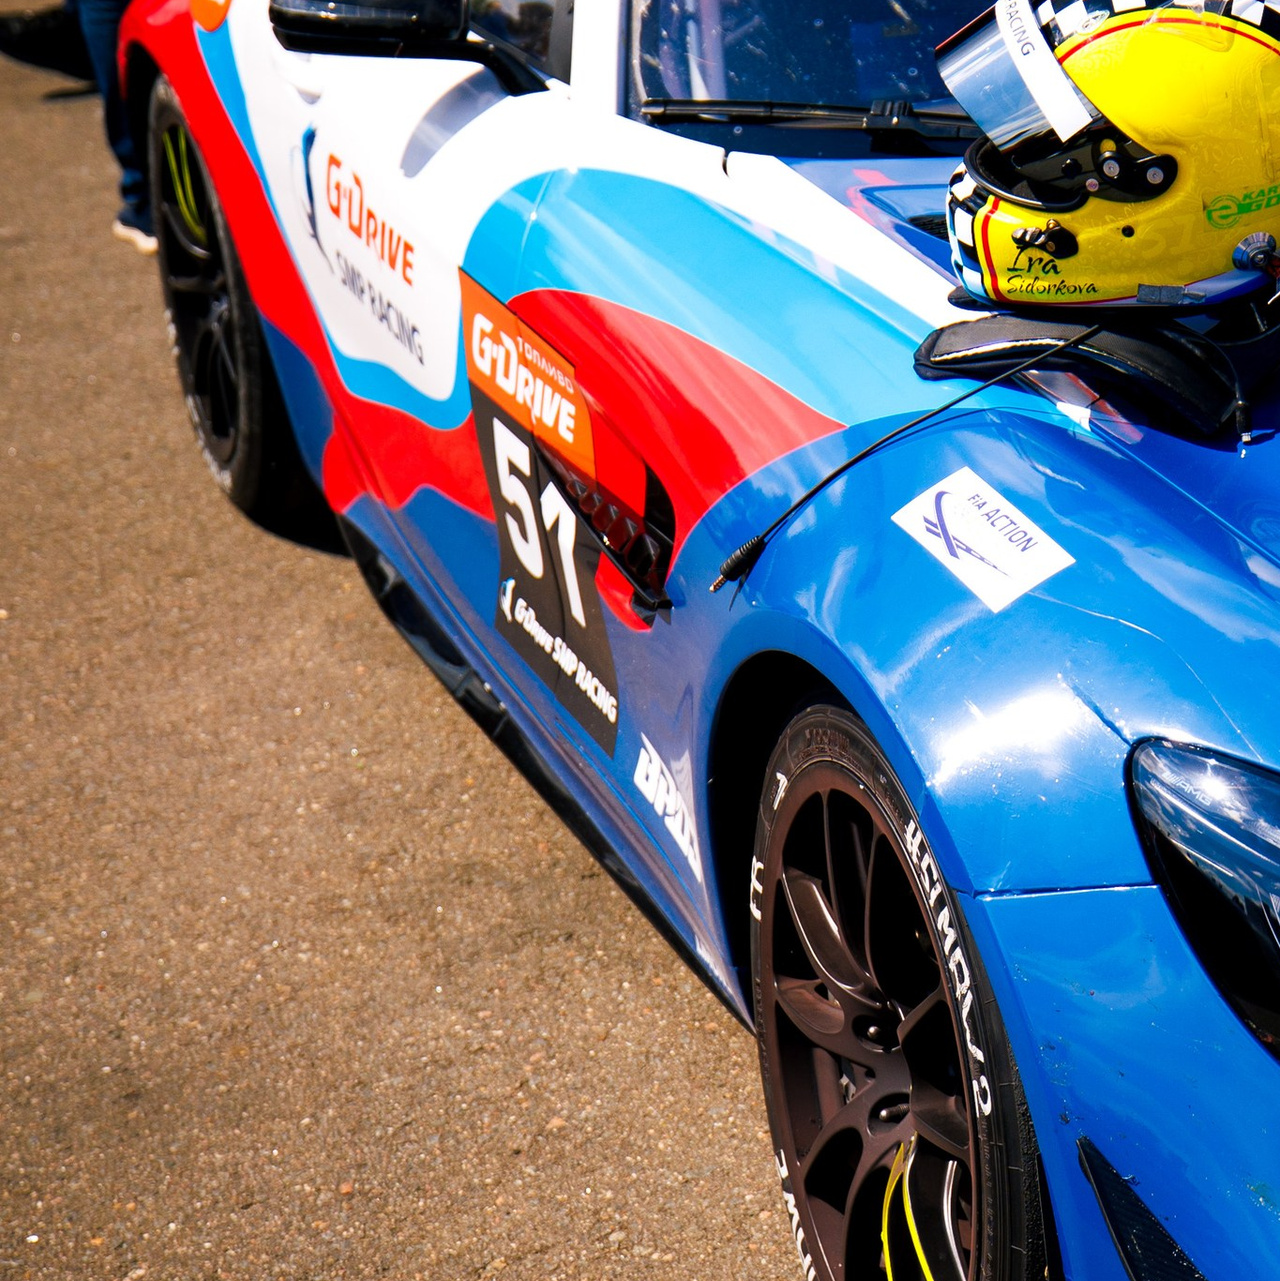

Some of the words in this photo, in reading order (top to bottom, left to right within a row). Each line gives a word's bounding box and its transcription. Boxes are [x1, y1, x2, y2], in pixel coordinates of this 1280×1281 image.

[1005, 1, 1036, 56] RACING
[1006, 245, 1063, 276] Ira
[1006, 275, 1100, 296] Sidorkova
[335, 250, 365, 303] SMP
[367, 279, 425, 366] RACING
[517, 335, 575, 396] ТОПЛИВО
[492, 416, 587, 628] 51
[981, 507, 1038, 553] ACTION
[551, 636, 579, 677] SMP
[574, 666, 618, 725] RACING
[1176, 780, 1213, 807] AMG
